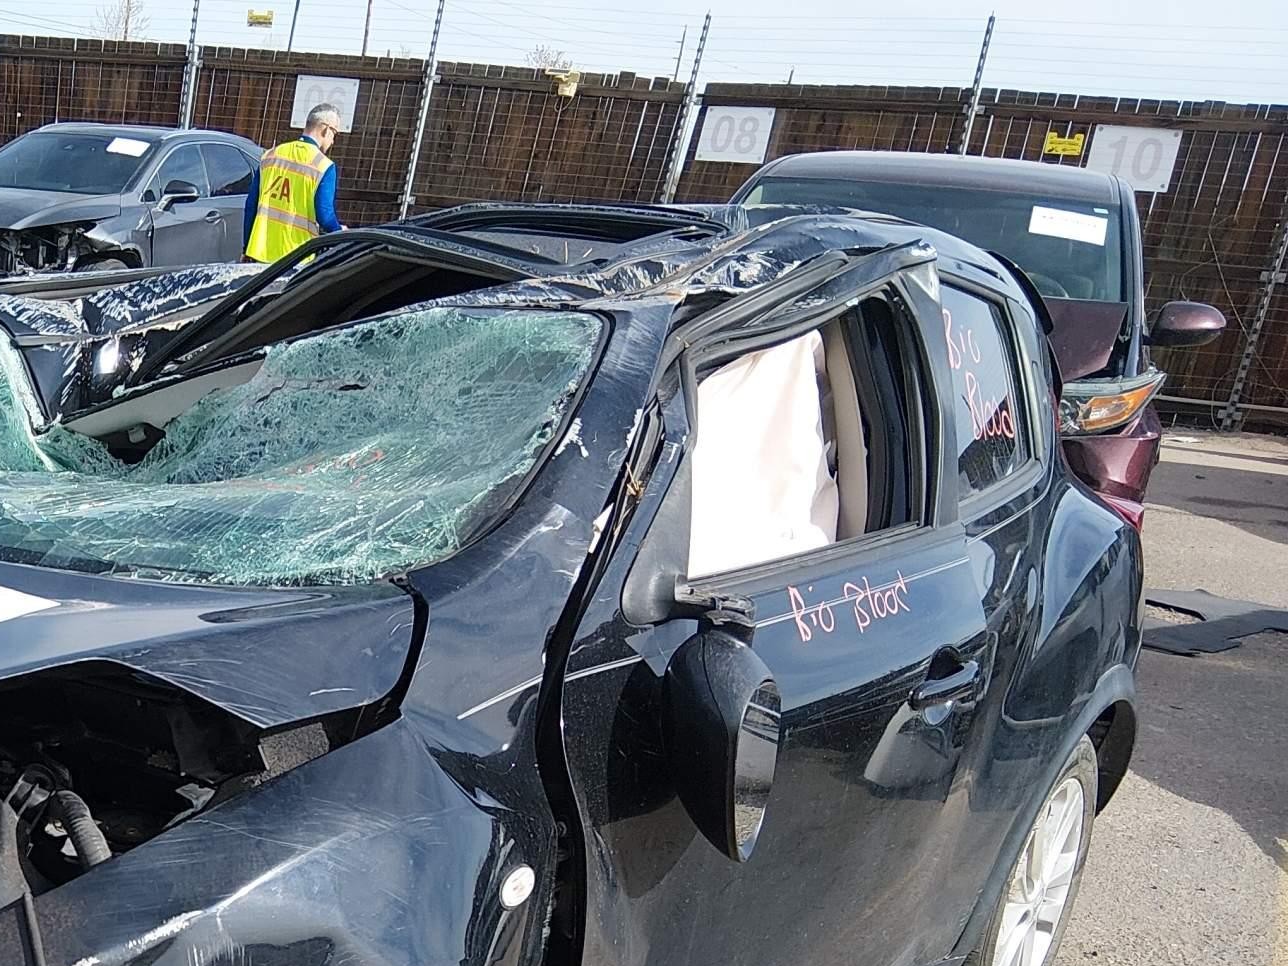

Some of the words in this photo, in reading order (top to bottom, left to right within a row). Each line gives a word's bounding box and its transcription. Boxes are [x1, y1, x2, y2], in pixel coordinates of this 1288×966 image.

[710, 114, 760, 154] 08
[1108, 135, 1163, 182] 10
[964, 372, 1015, 441] Blood
[787, 585, 836, 643] Bio
[842, 570, 912, 634] Blood
